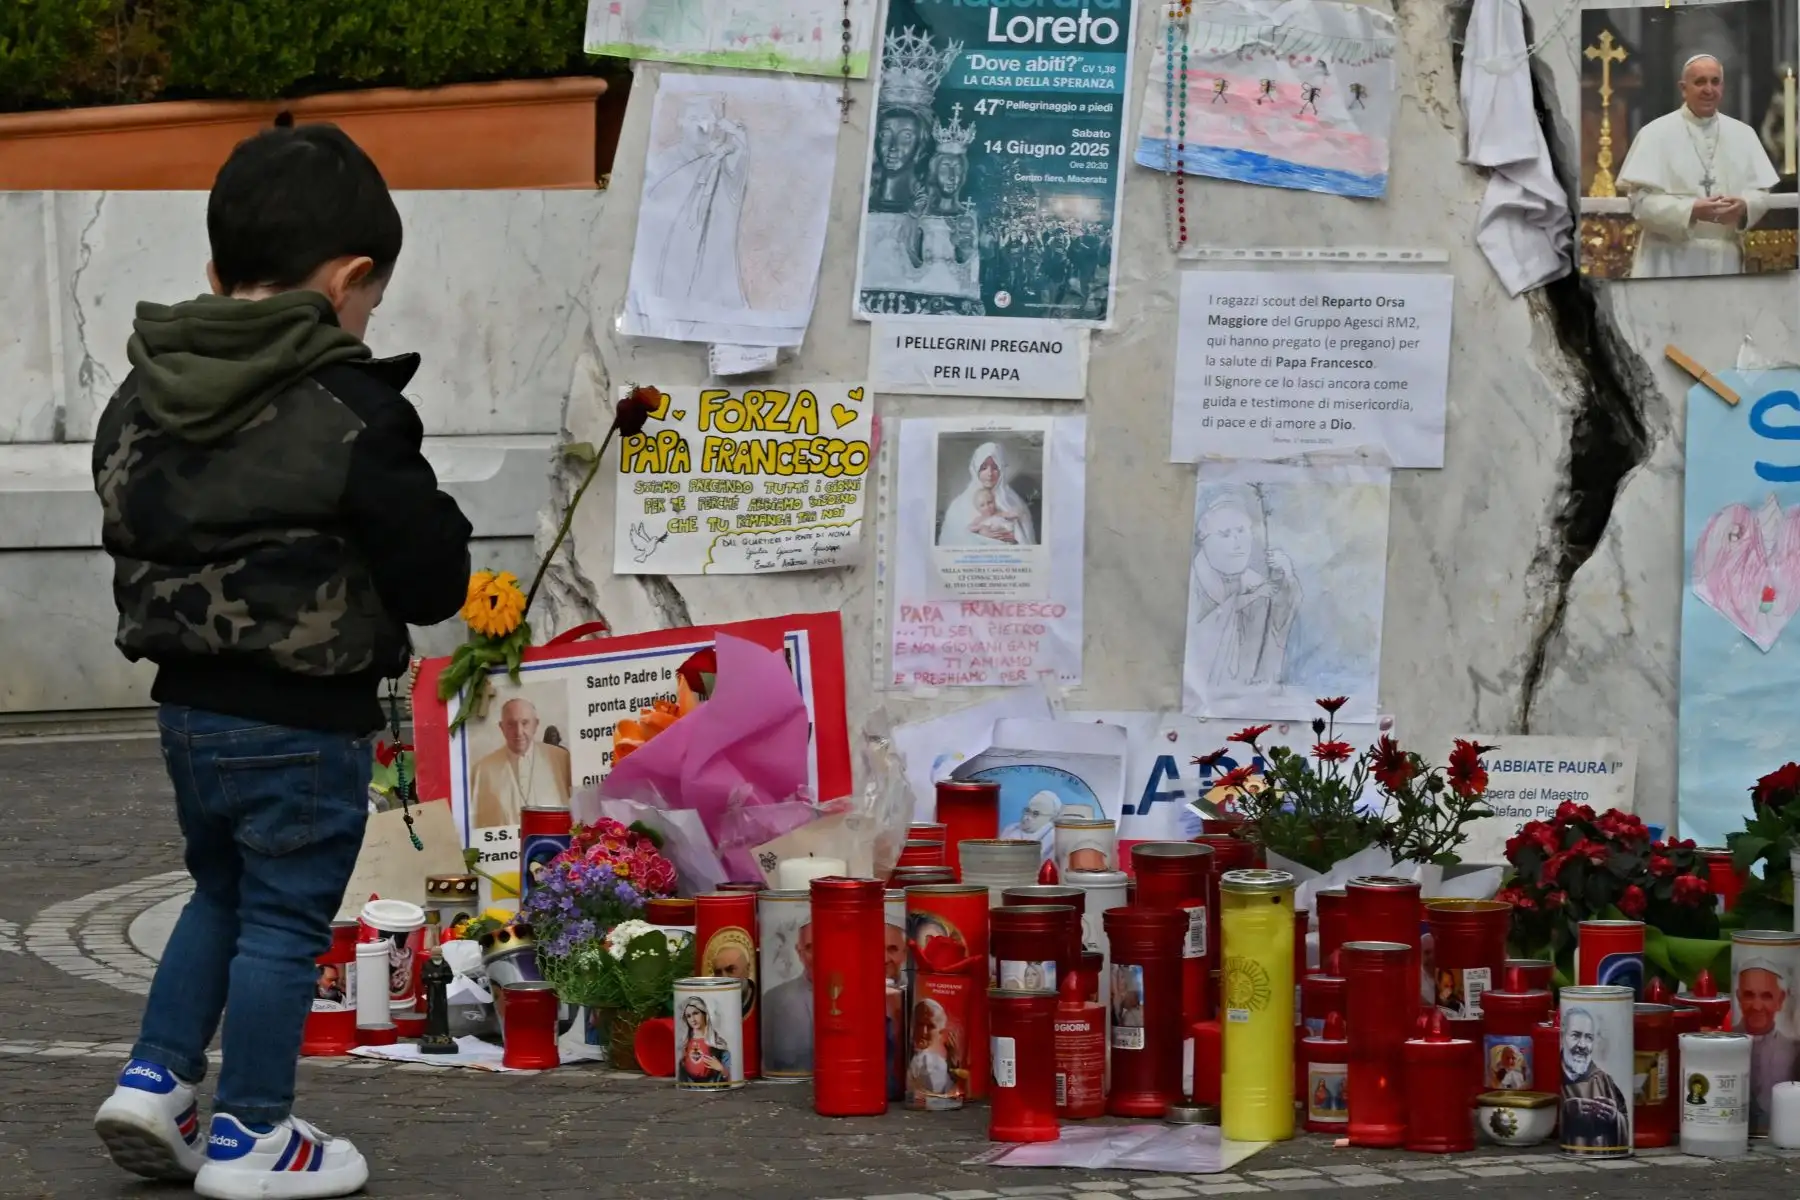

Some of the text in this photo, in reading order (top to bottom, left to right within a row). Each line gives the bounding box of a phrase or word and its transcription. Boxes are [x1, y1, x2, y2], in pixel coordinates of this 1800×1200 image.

[988, 7, 1119, 45] Loreto
[966, 55, 1021, 72] "Dove
[1025, 55, 1083, 73] abiti?"
[964, 75, 1115, 89] LA CASA DELLA SPERANZA
[1006, 100, 1077, 112] Pellegrinaggio
[1088, 103, 1113, 112] piedi
[1072, 128, 1111, 138] Sabato
[984, 140, 1110, 158] 14 Giugno 2025
[1069, 161, 1084, 169] Ore
[1209, 295, 1405, 310] I ragazzi scout del Reparto Orsa
[1208, 314, 1420, 330] Maggiore del Gruppo Agesci RM2,
[897, 336, 1062, 354] I PELLEGRINI PREGANO
[1207, 336, 1420, 351] qui hanno pregato (e pregano) per
[1206, 355, 1377, 370] la salute di Papa Francesco.
[934, 365, 1020, 381] PER IL PAPA
[1204, 375, 1408, 390] Il Signore ce lo lasci ancora come
[1202, 396, 1414, 412] guida e testimone di misericordia,
[698, 389, 819, 435] FORZA
[1202, 416, 1356, 431] di pace e di amore a Dio.
[620, 430, 870, 477] PAPA FRANCESCO
[644, 498, 665, 514] PER
[667, 516, 699, 534] CHE
[707, 517, 729, 533] TU
[900, 601, 1067, 623] PAPA FRANCESCO
[948, 625, 974, 638] SEI
[989, 622, 1046, 636] PIETRO
[895, 641, 906, 656] E
[911, 643, 936, 655] NOI
[941, 642, 1001, 655] GIOVANI
[943, 656, 1033, 669] TI AMIAMO
[587, 667, 671, 688] Santo Padre le
[894, 672, 906, 685] E
[913, 671, 988, 685] PREGHIAMO
[1000, 670, 1027, 683] PER
[588, 697, 626, 716] pronta
[630, 692, 677, 712] guarigio
[1492, 760, 1554, 773] ABBIATE
[1558, 761, 1607, 774] PAURA
[1519, 788, 1537, 800] del
[1541, 790, 1589, 801] Maestro
[484, 829, 512, 842] S.S.
[478, 851, 520, 862] Franc
[125, 1064, 162, 1083] adidas
[207, 1134, 238, 1148] adidas
